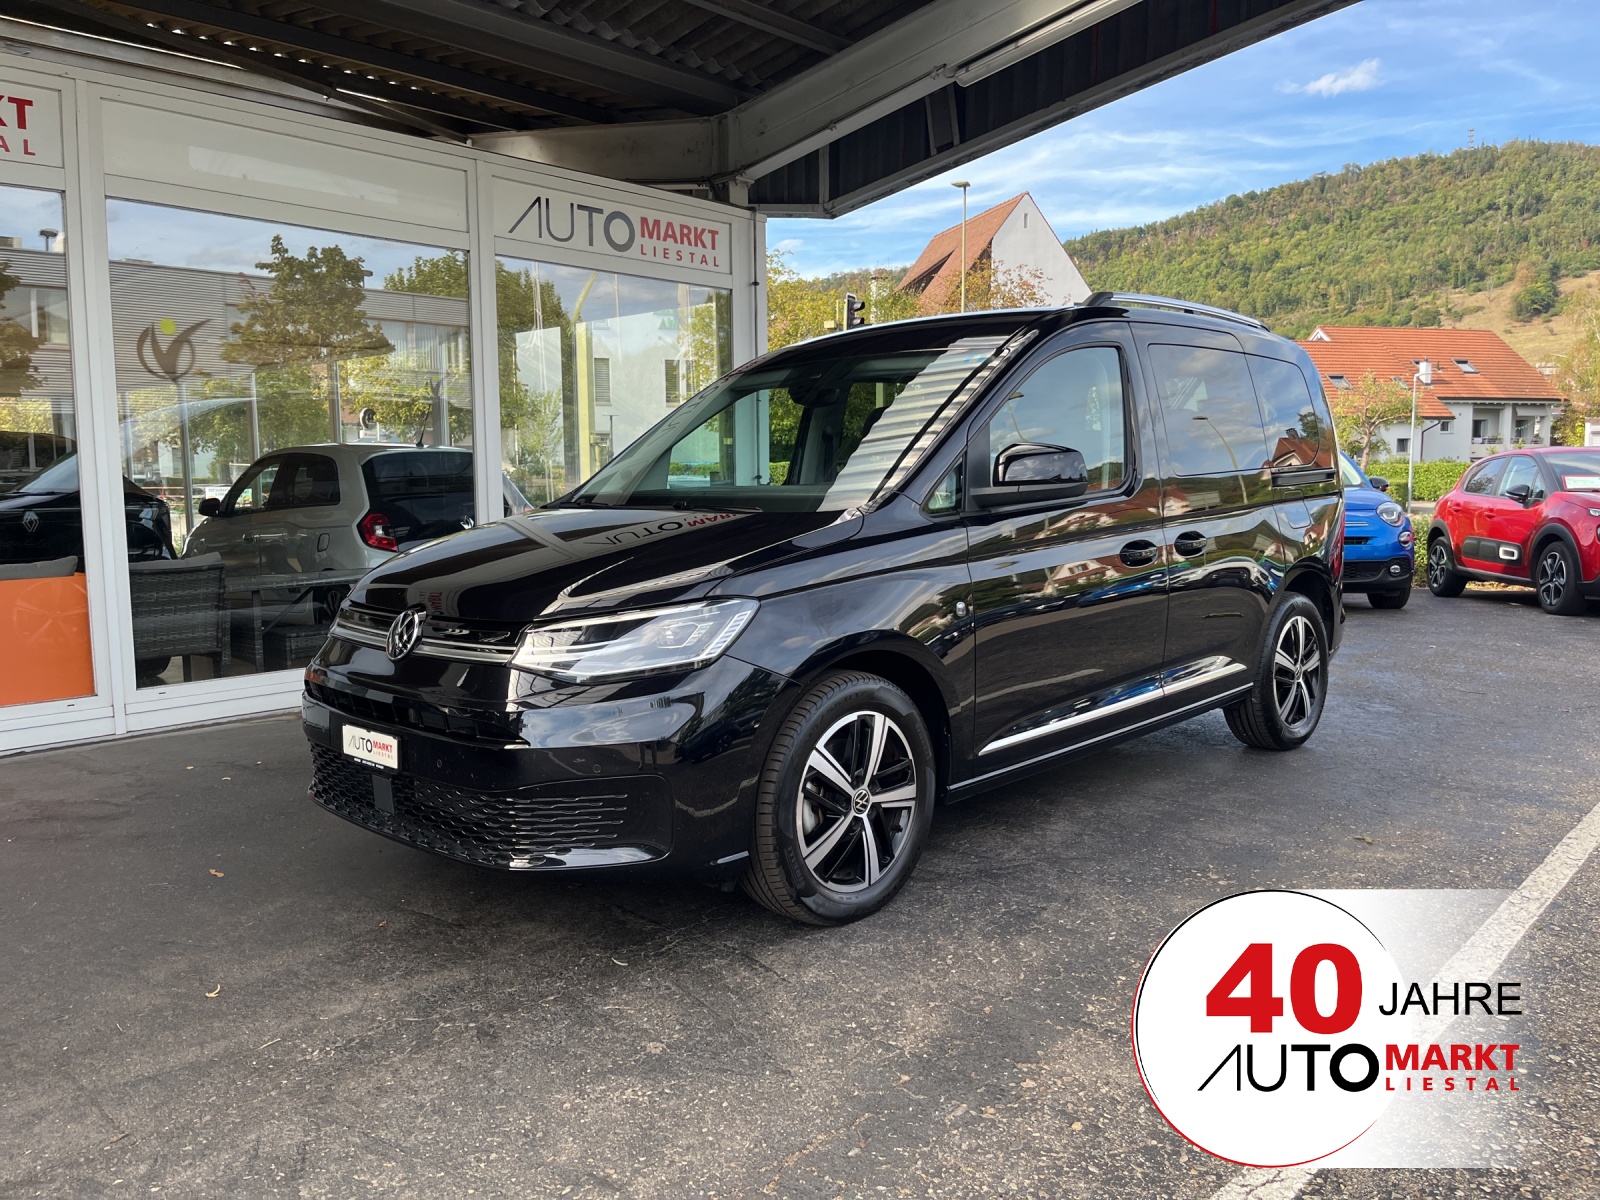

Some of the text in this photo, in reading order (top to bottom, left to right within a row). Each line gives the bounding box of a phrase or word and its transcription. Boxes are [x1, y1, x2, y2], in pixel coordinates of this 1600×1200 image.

[508, 196, 720, 252] AUTO MARKT
[640, 244, 720, 268] LIESTAL
[348, 734, 393, 753] AUTO MARKT
